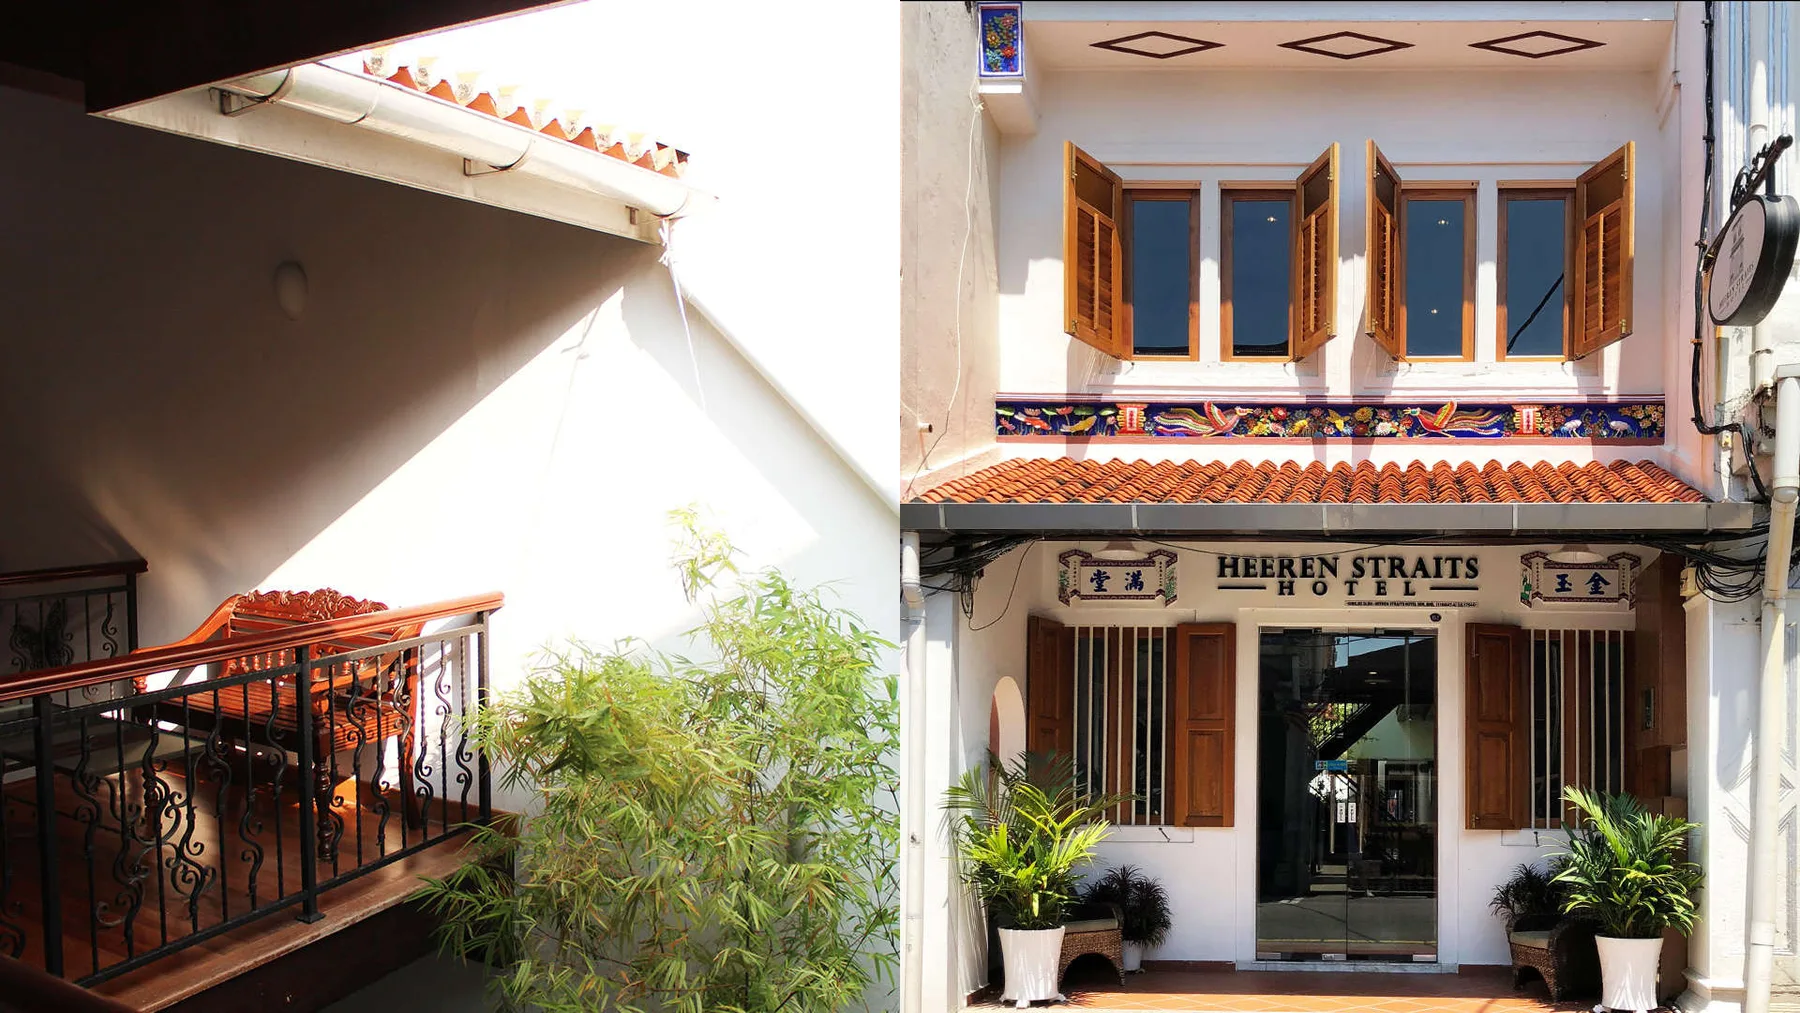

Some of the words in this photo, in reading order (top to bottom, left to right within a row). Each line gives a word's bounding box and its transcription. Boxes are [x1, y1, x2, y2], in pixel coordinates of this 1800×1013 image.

[1217, 556, 1339, 579] HEEREN
[1351, 556, 1480, 580] STRAITS
[1277, 580, 1417, 596] HOTEL
